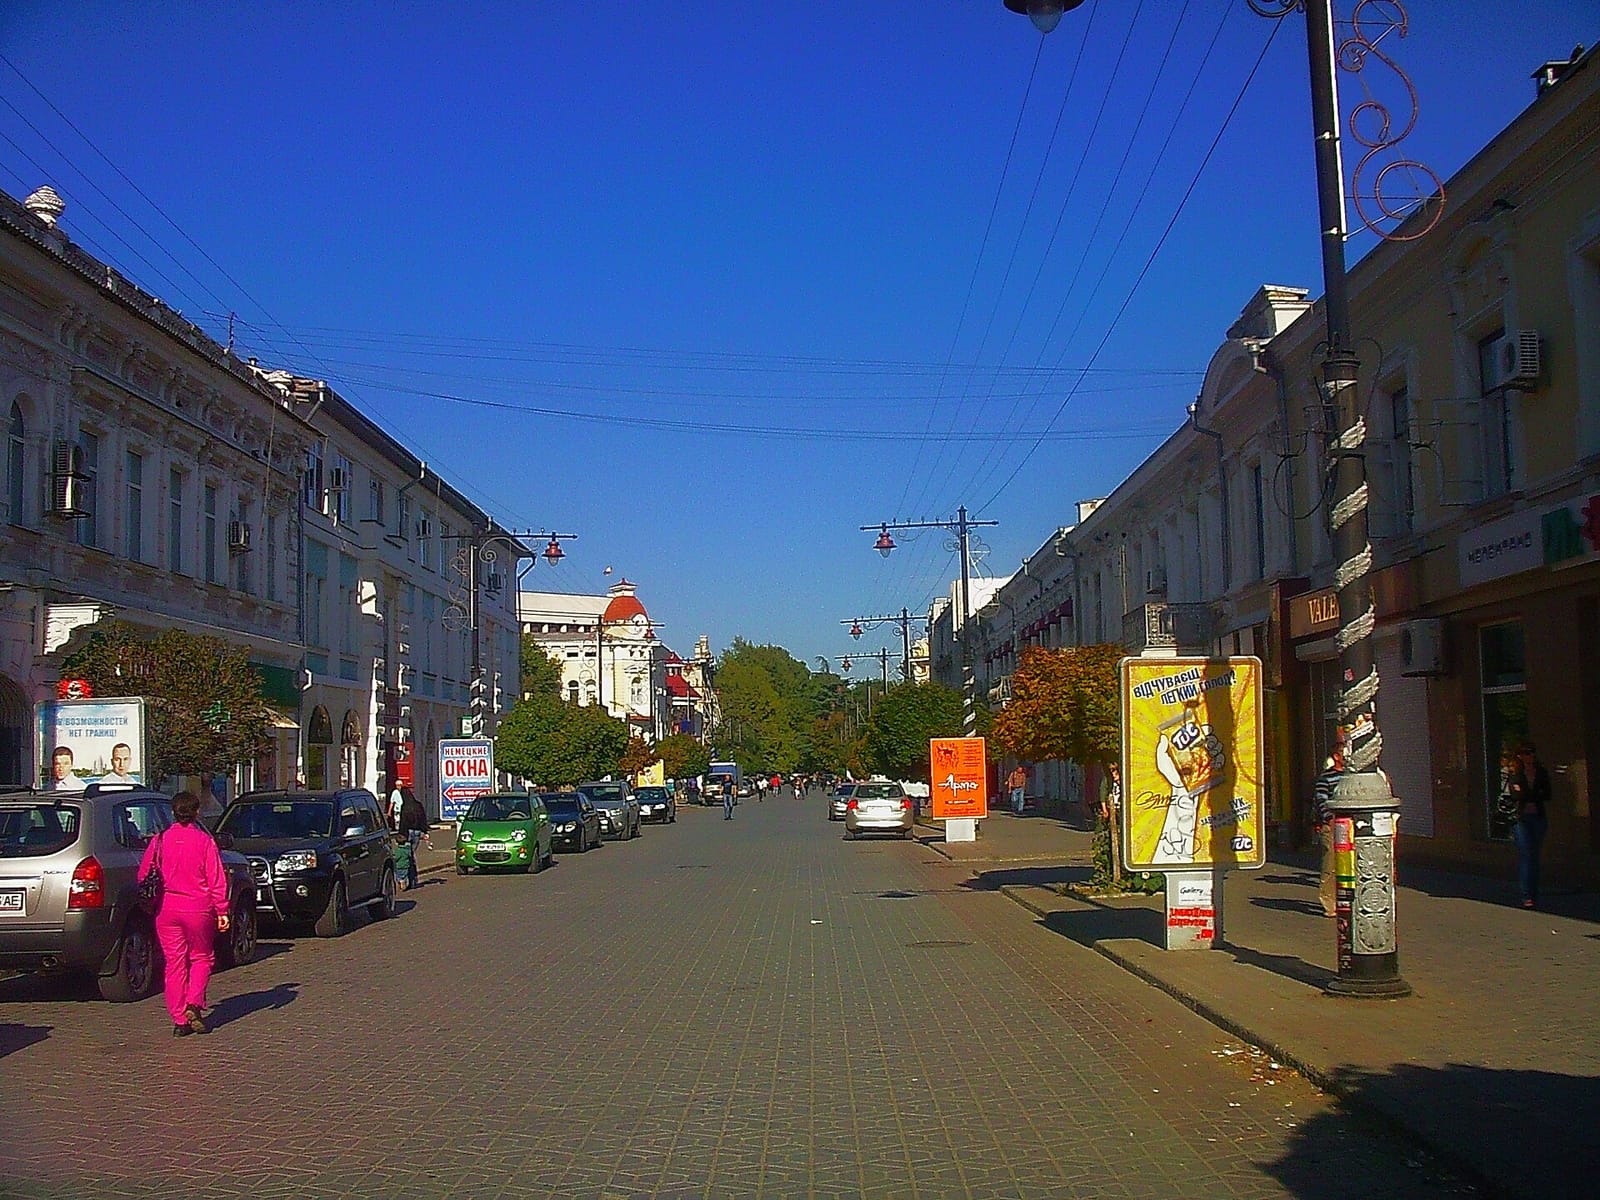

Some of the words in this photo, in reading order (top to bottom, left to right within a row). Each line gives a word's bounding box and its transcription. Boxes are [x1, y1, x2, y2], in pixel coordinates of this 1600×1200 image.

[1133, 667, 1200, 698] ВІДЧУВАЄШ
[1161, 683, 1199, 704] ЛЕГКИЙ
[69, 729, 82, 738] НЕТ
[1172, 723, 1200, 750] TUC
[445, 747, 488, 757] НЕМЕЦКИЕ
[445, 759, 488, 777] ОКНА
[1231, 838, 1252, 849] TUC
